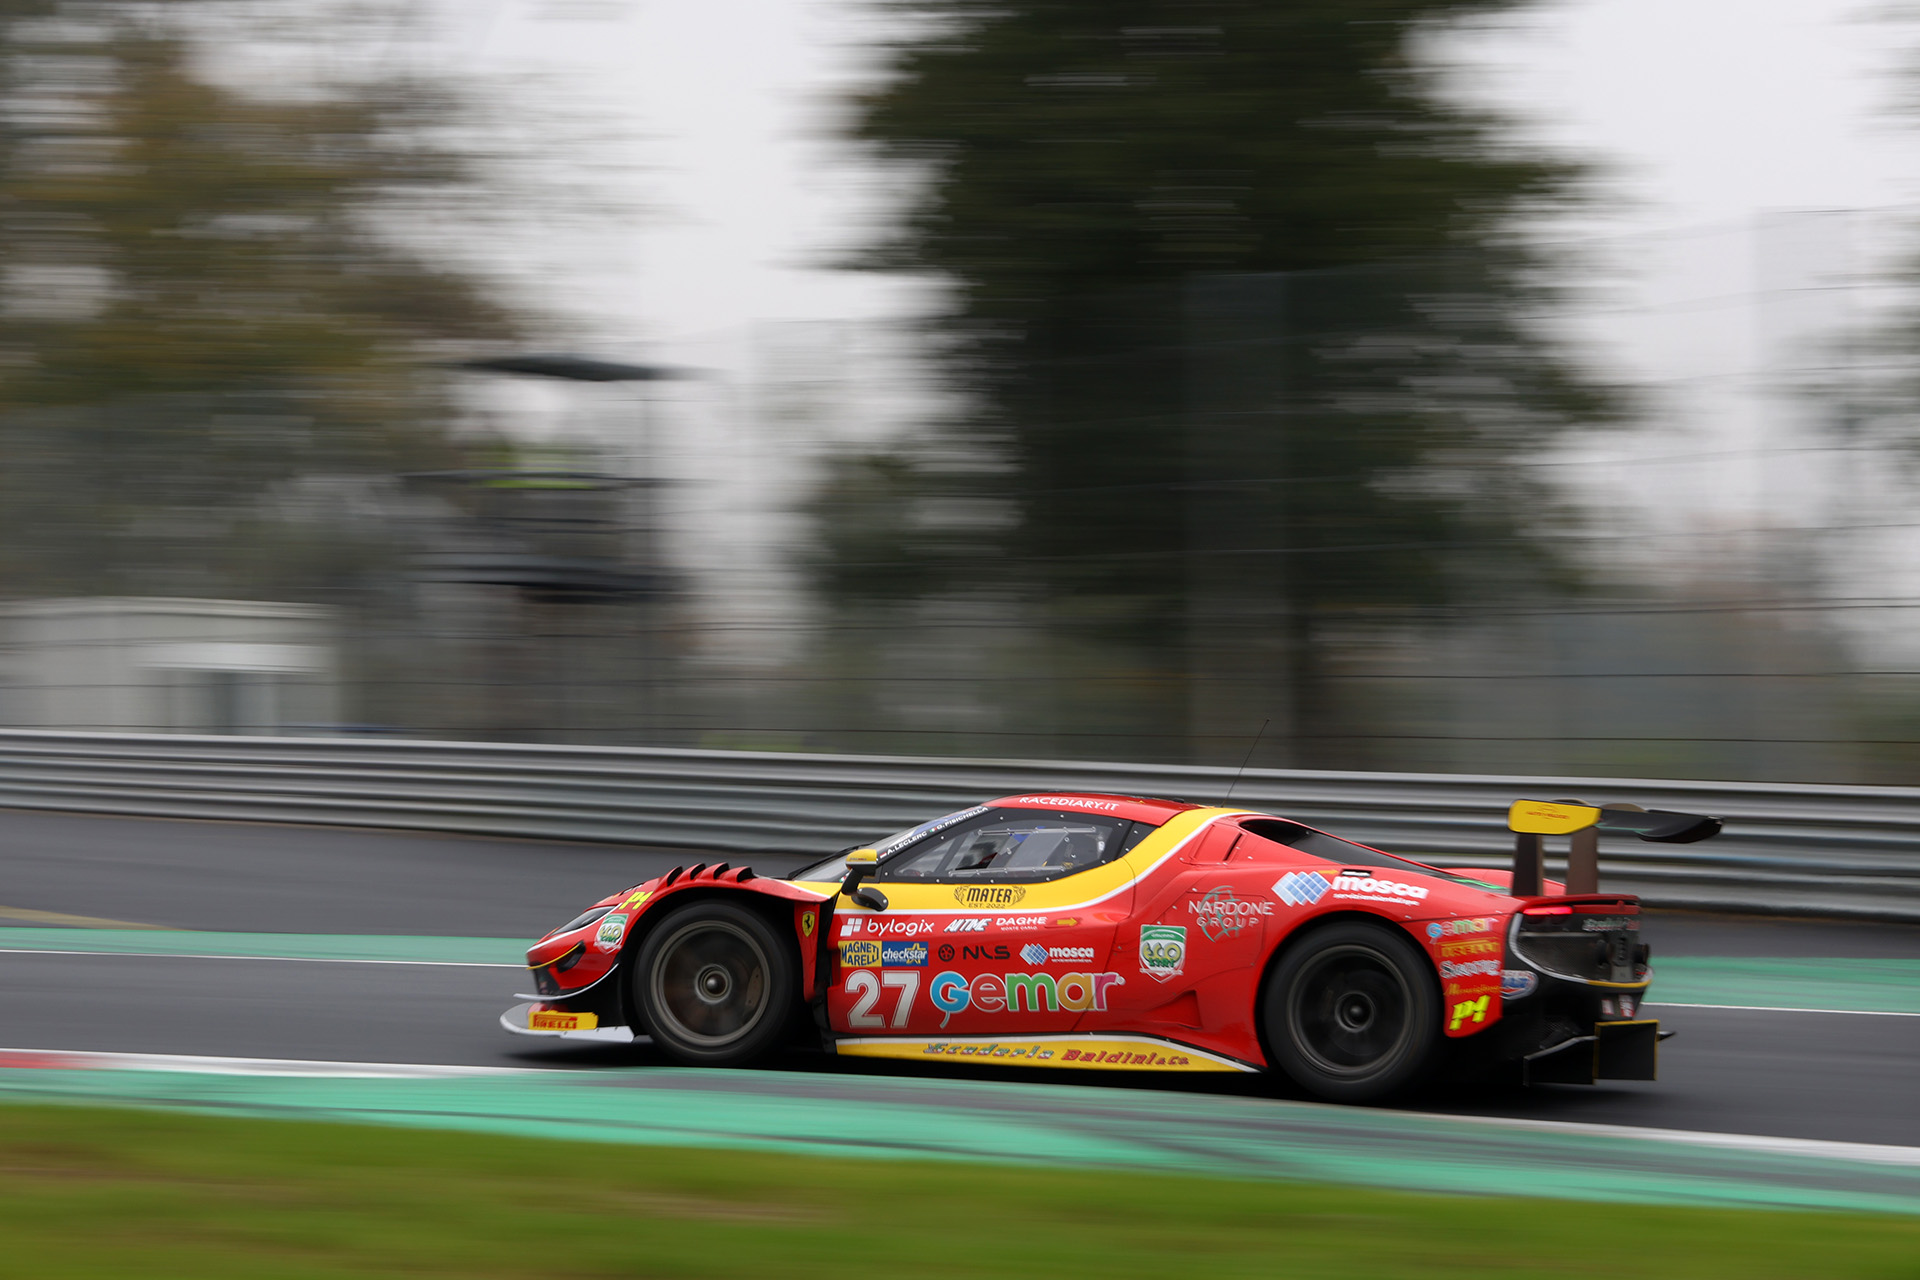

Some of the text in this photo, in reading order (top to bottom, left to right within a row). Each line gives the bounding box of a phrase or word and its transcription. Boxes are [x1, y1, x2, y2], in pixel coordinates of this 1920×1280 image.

[1019, 797, 1119, 811] RACEDIARY.IT
[966, 888, 1012, 903] MATER
[1331, 876, 1429, 900] mosca
[1188, 900, 1276, 916] NARDONE
[867, 918, 935, 937] bylogix
[996, 916, 1048, 927] DAGHE
[1196, 916, 1259, 928] GROUP
[882, 948, 928, 960] checkstar
[963, 946, 1011, 960] NLS
[1049, 947, 1095, 958] mosca
[845, 969, 920, 1028] 27
[931, 970, 1118, 1029] Gemar
[533, 1014, 578, 1029] PIRELLI
[932, 1043, 1055, 1060] Scuderia
[1061, 1049, 1157, 1065] Baldini
